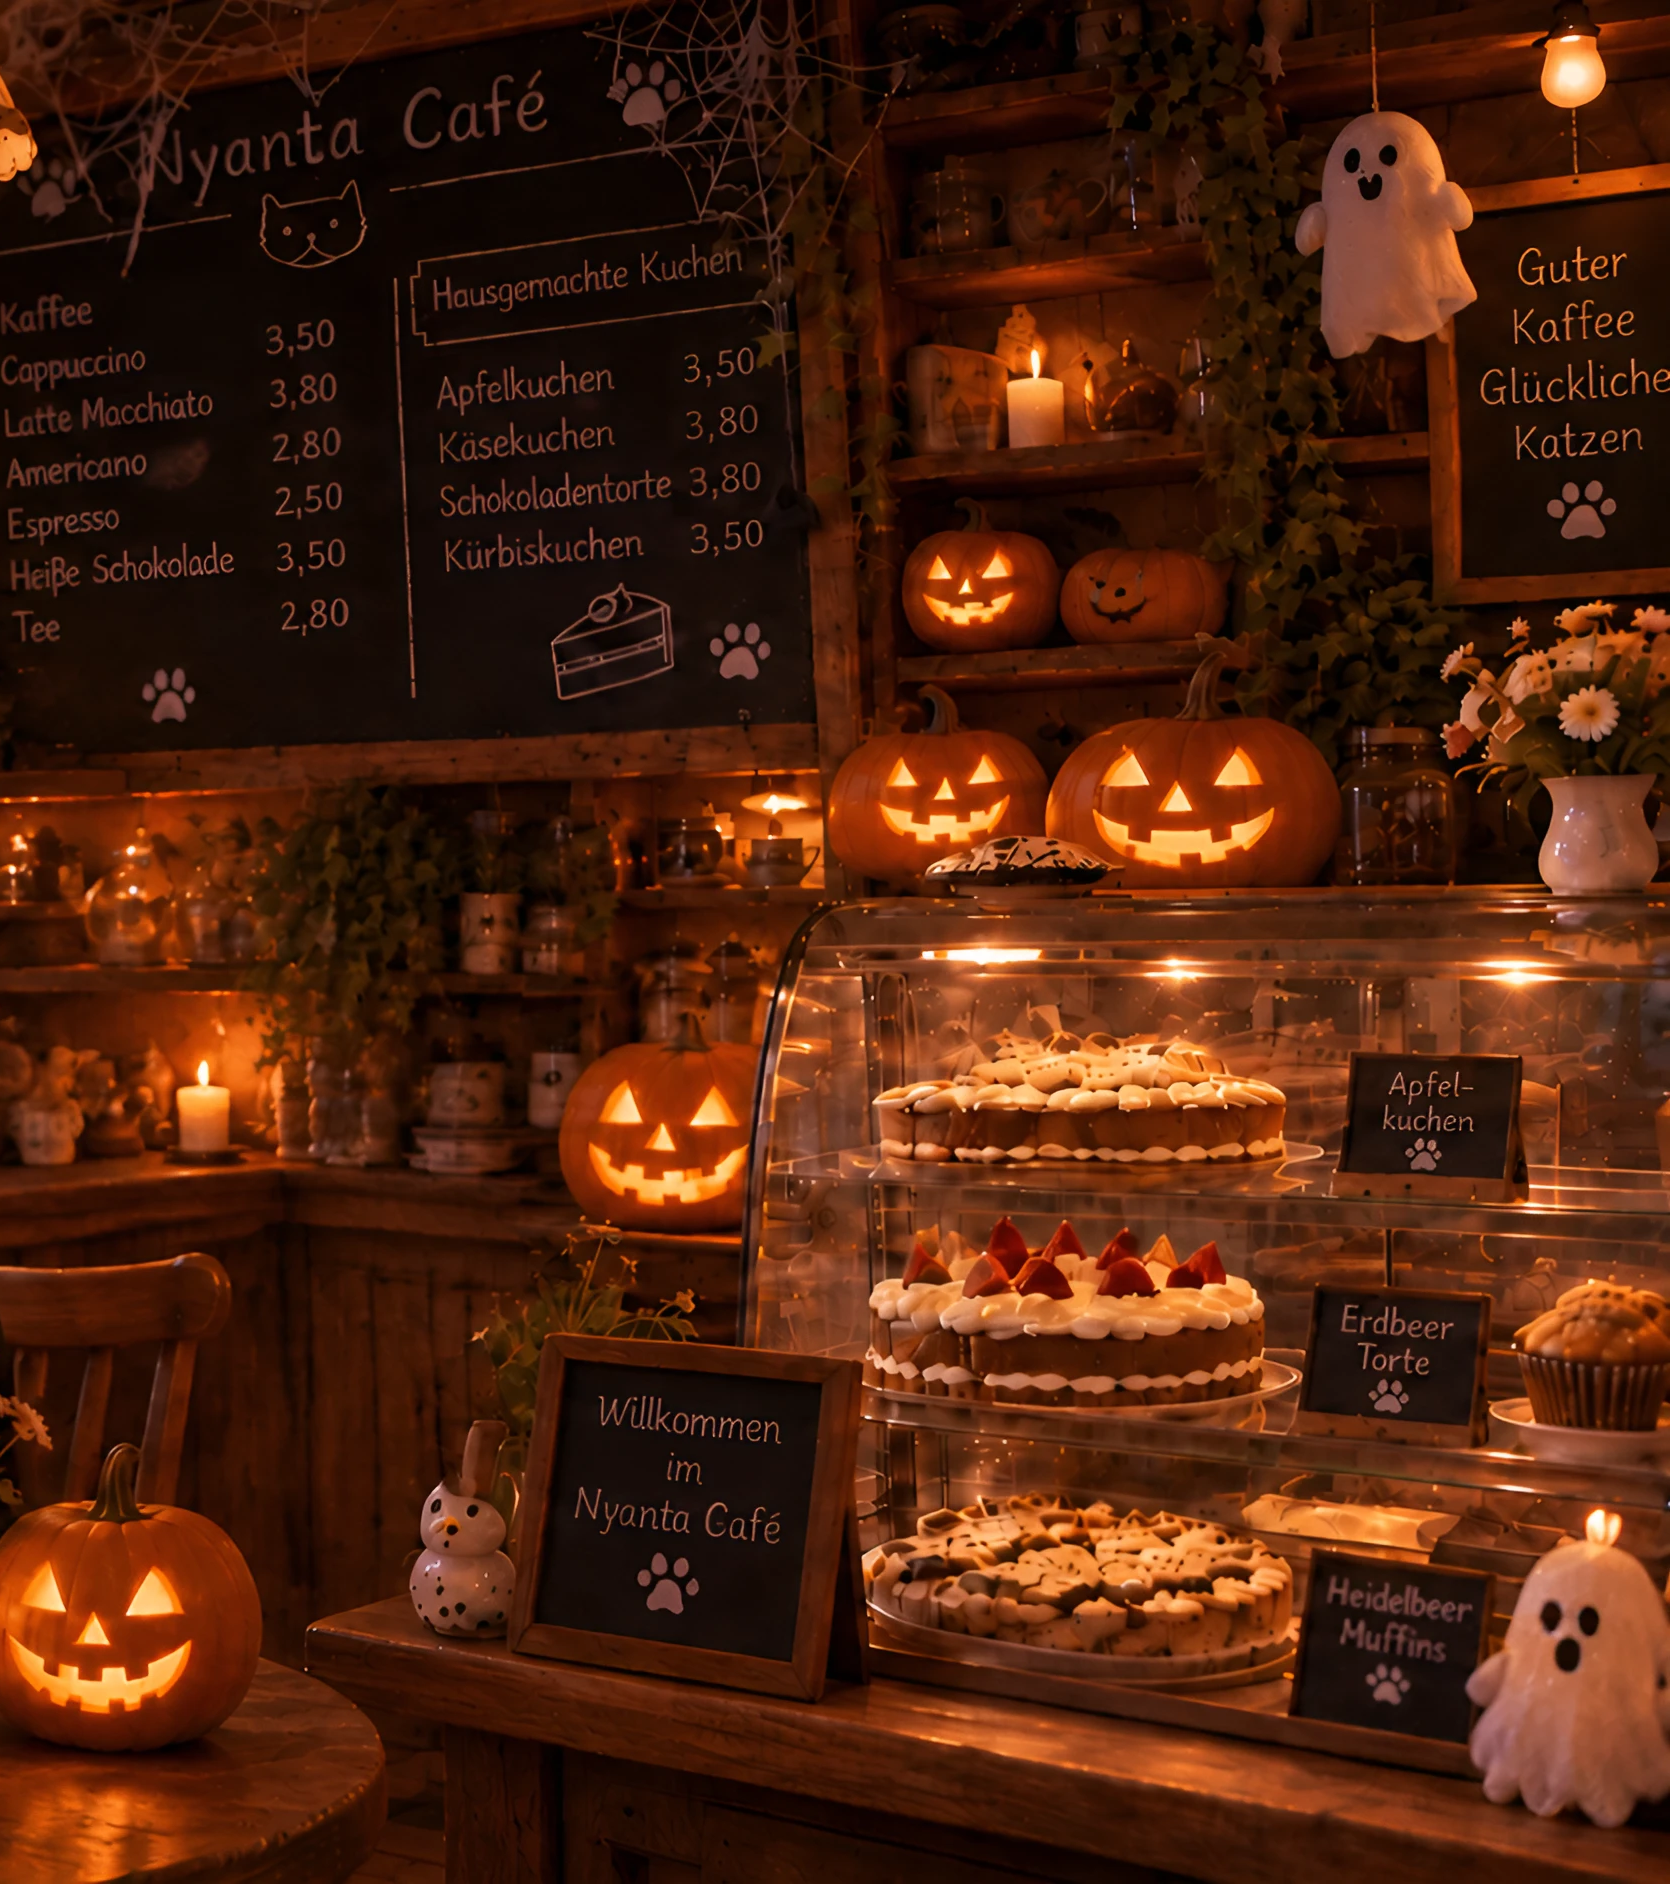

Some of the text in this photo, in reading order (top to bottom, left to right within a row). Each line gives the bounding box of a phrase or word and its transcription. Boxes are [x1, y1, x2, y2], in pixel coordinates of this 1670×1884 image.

[402, 69, 548, 149] Café
[433, 243, 743, 313] Hausgemachte Kuchen
[1517, 246, 1628, 286] Guter
[0, 293, 93, 335] Kaffee
[1513, 299, 1636, 345] Kaffee
[0, 318, 336, 393] Cappuccino 3,50
[4, 373, 338, 438] Latte Macchiato 3,80
[437, 347, 755, 416] Apfelkuchen 3,50
[1480, 358, 1670, 406] Glückliche
[6, 427, 342, 489] Americano 2,80
[439, 404, 759, 464] Käsekuchen 3,80
[1515, 422, 1644, 461] Katzen
[7, 482, 344, 546] Espresso 2,50
[440, 461, 762, 518] Schokoladentorte 3,80
[9, 538, 347, 598] Heiße Schokolade 3,50
[444, 519, 765, 573] Kürbiskuchen 3,50
[11, 597, 350, 643] Tee 2,80
[1388, 1071, 1474, 1105] Apfel-
[1382, 1105, 1475, 1133] kuchen
[1340, 1304, 1455, 1341] Erdbeer
[1357, 1342, 1431, 1377] Torte
[598, 1394, 783, 1446] Willkommen
[666, 1452, 703, 1486] im
[574, 1487, 782, 1546] Nyanta Café
[1326, 1574, 1474, 1623] Heidelbeer
[1339, 1617, 1448, 1664] Muffins
